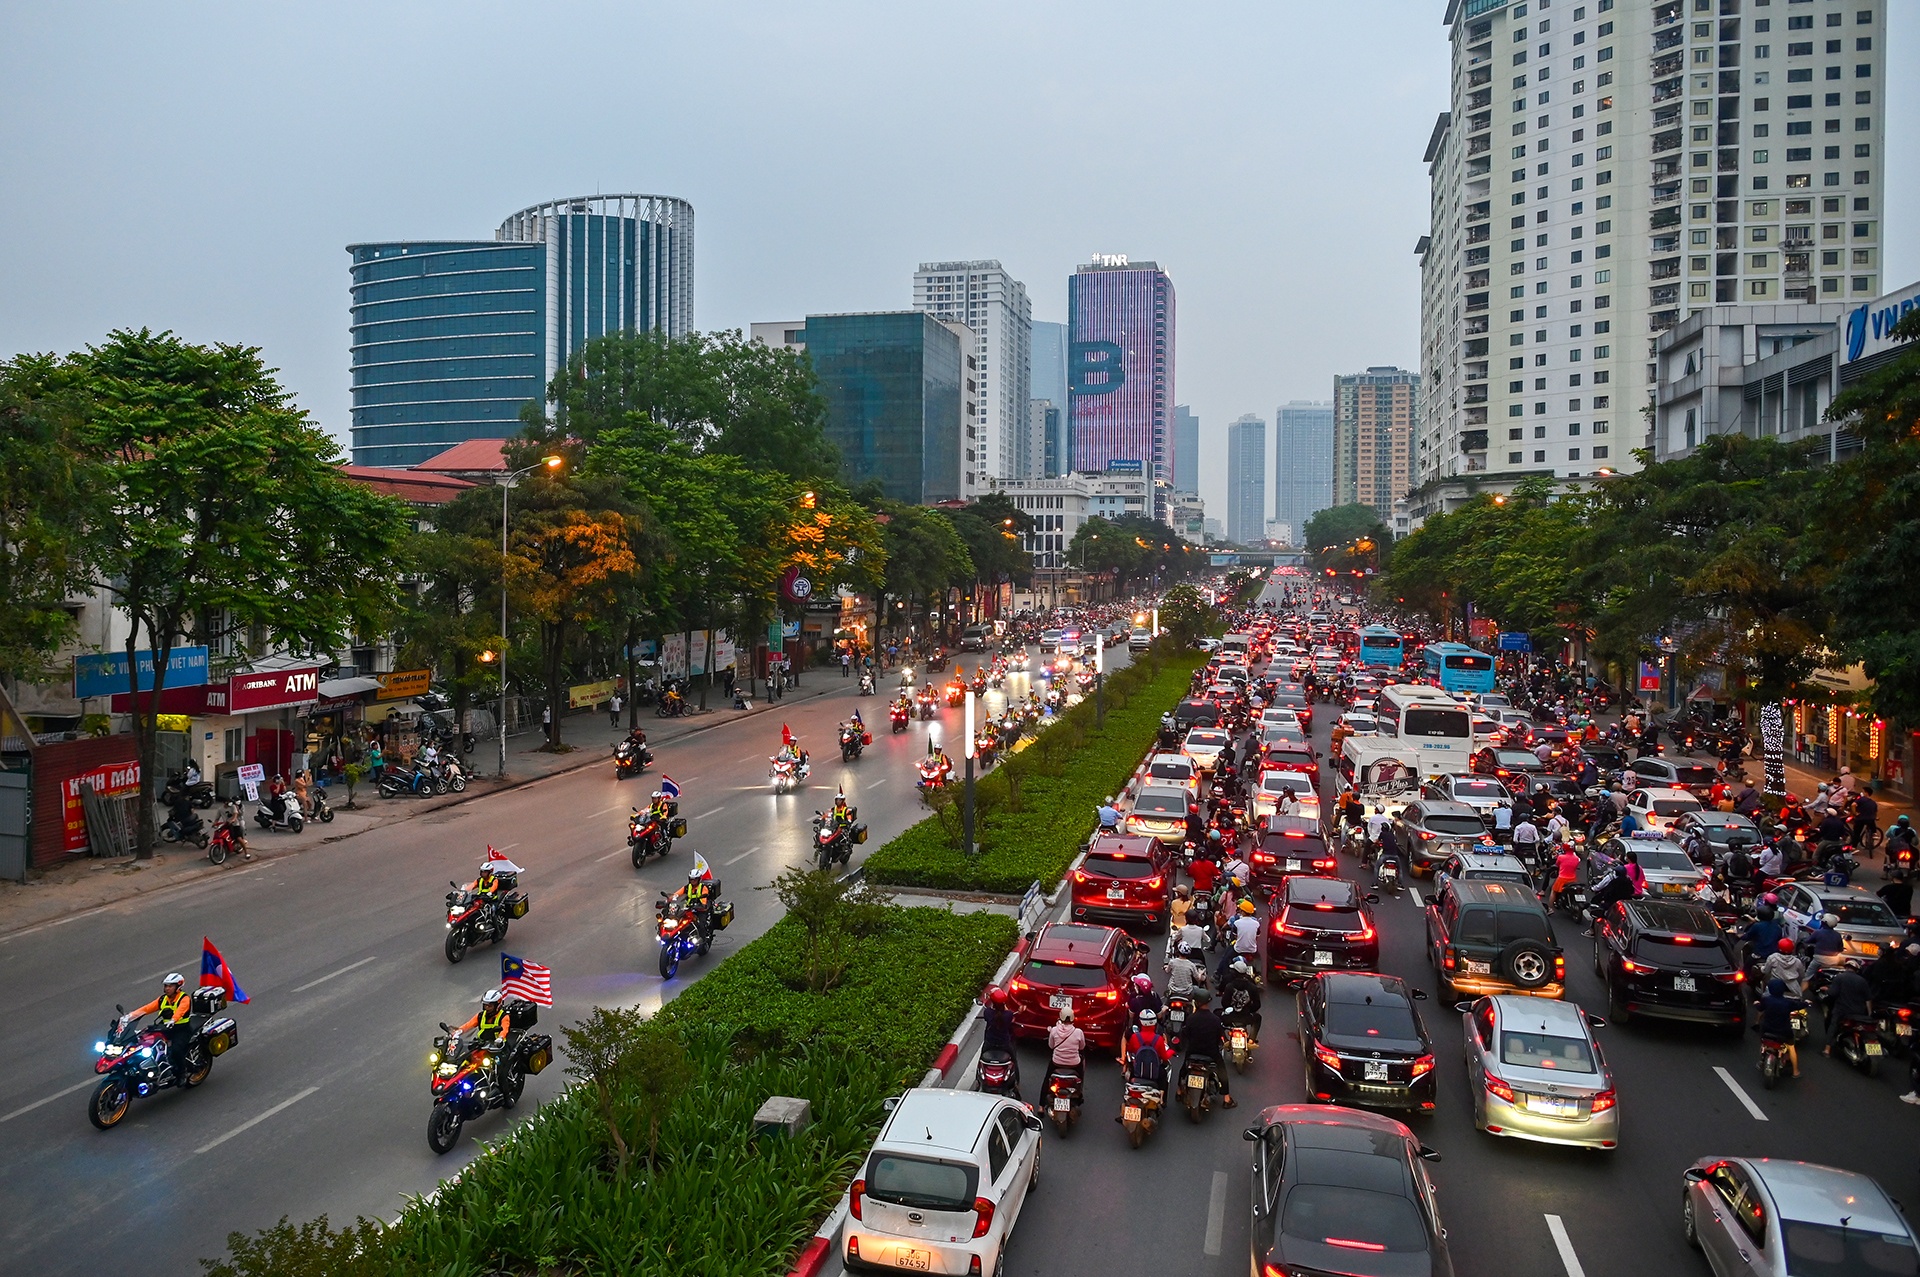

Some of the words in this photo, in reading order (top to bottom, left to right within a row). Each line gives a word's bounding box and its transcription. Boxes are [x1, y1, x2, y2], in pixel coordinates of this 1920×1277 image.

[171, 654, 187, 671] VIỆT
[188, 655, 205, 670] NAM
[242, 679, 277, 690] AGRIBANK
[284, 672, 317, 693] ATM
[207, 692, 226, 707] ATM
[1368, 782, 1390, 794] Meat
[1390, 779, 1408, 790] Plus
[899, 1258, 926, 1269] 674.52
